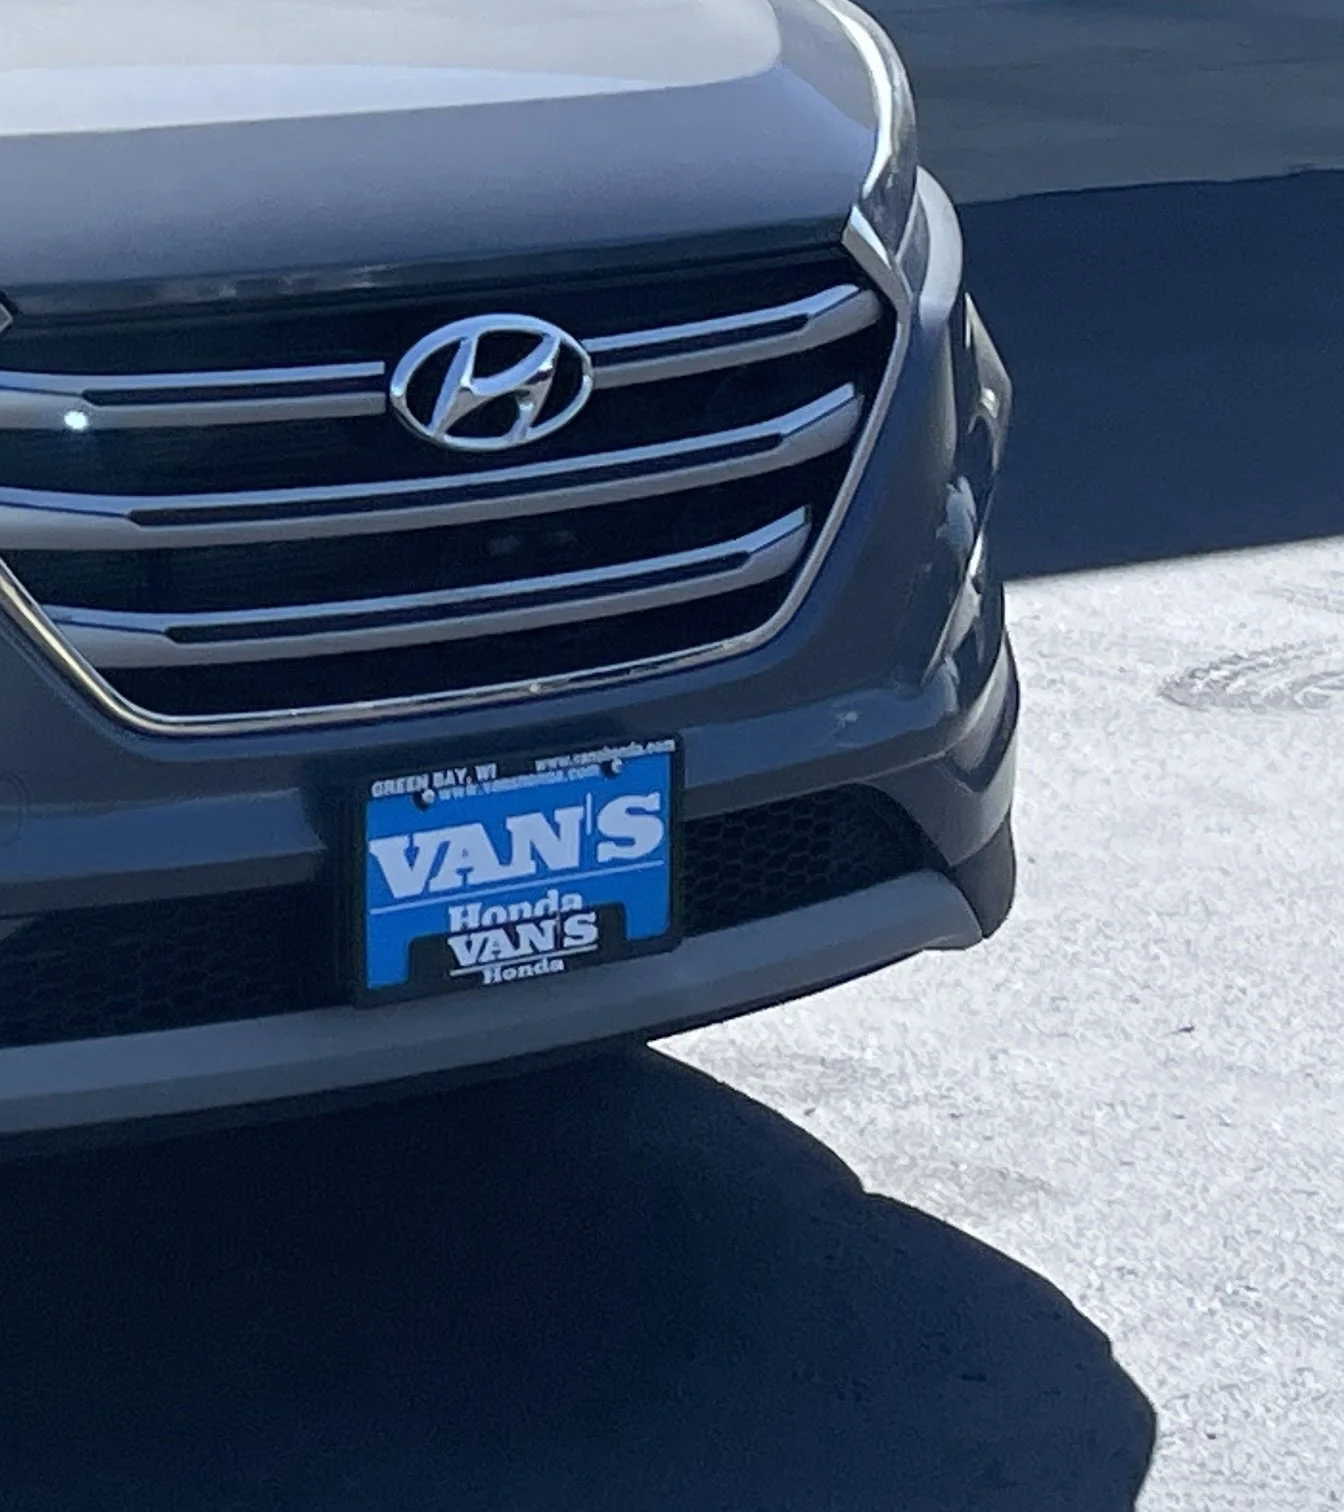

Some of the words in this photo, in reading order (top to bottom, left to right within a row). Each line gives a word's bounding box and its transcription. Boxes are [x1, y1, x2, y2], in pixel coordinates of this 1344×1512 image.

[475, 763, 497, 782] WI
[369, 791, 665, 899] VAN'S
[449, 889, 583, 933] Honda
[447, 911, 599, 967] VAN'S
[483, 958, 565, 985] Honda
